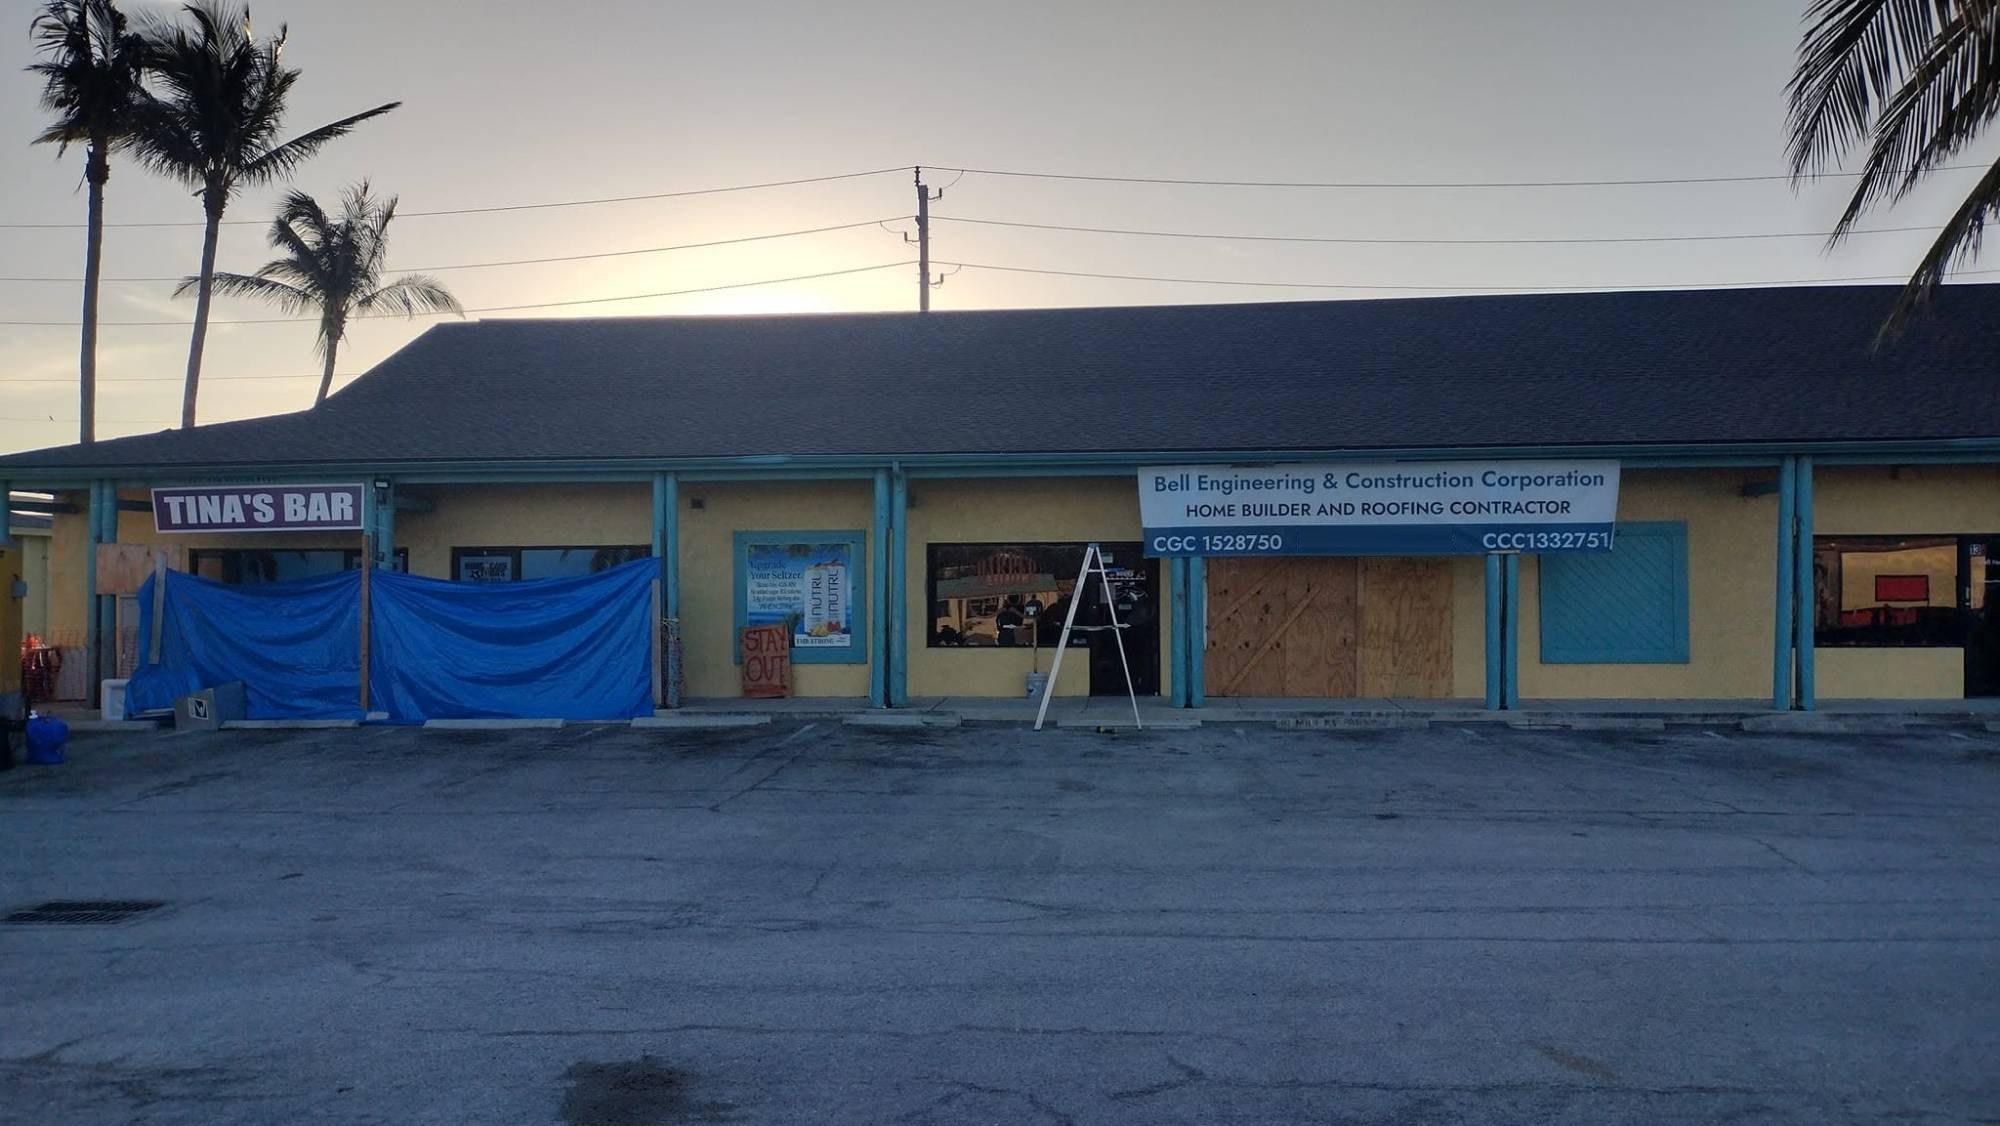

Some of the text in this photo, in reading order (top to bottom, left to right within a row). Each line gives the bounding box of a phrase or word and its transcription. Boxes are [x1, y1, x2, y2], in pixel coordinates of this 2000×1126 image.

[1154, 469, 1604, 495] Bell Engineering & Construction Corporation
[163, 492, 354, 525] TINA'S BAR
[1186, 500, 1571, 518] HOME BUILDER AND ROOFING CONTRACTOR
[1153, 534, 1283, 552] CGC 1528750
[1482, 531, 1609, 549] CCC1332751
[750, 571, 770, 580] Your
[745, 625, 787, 654] STAY
[746, 655, 788, 684] OUT
